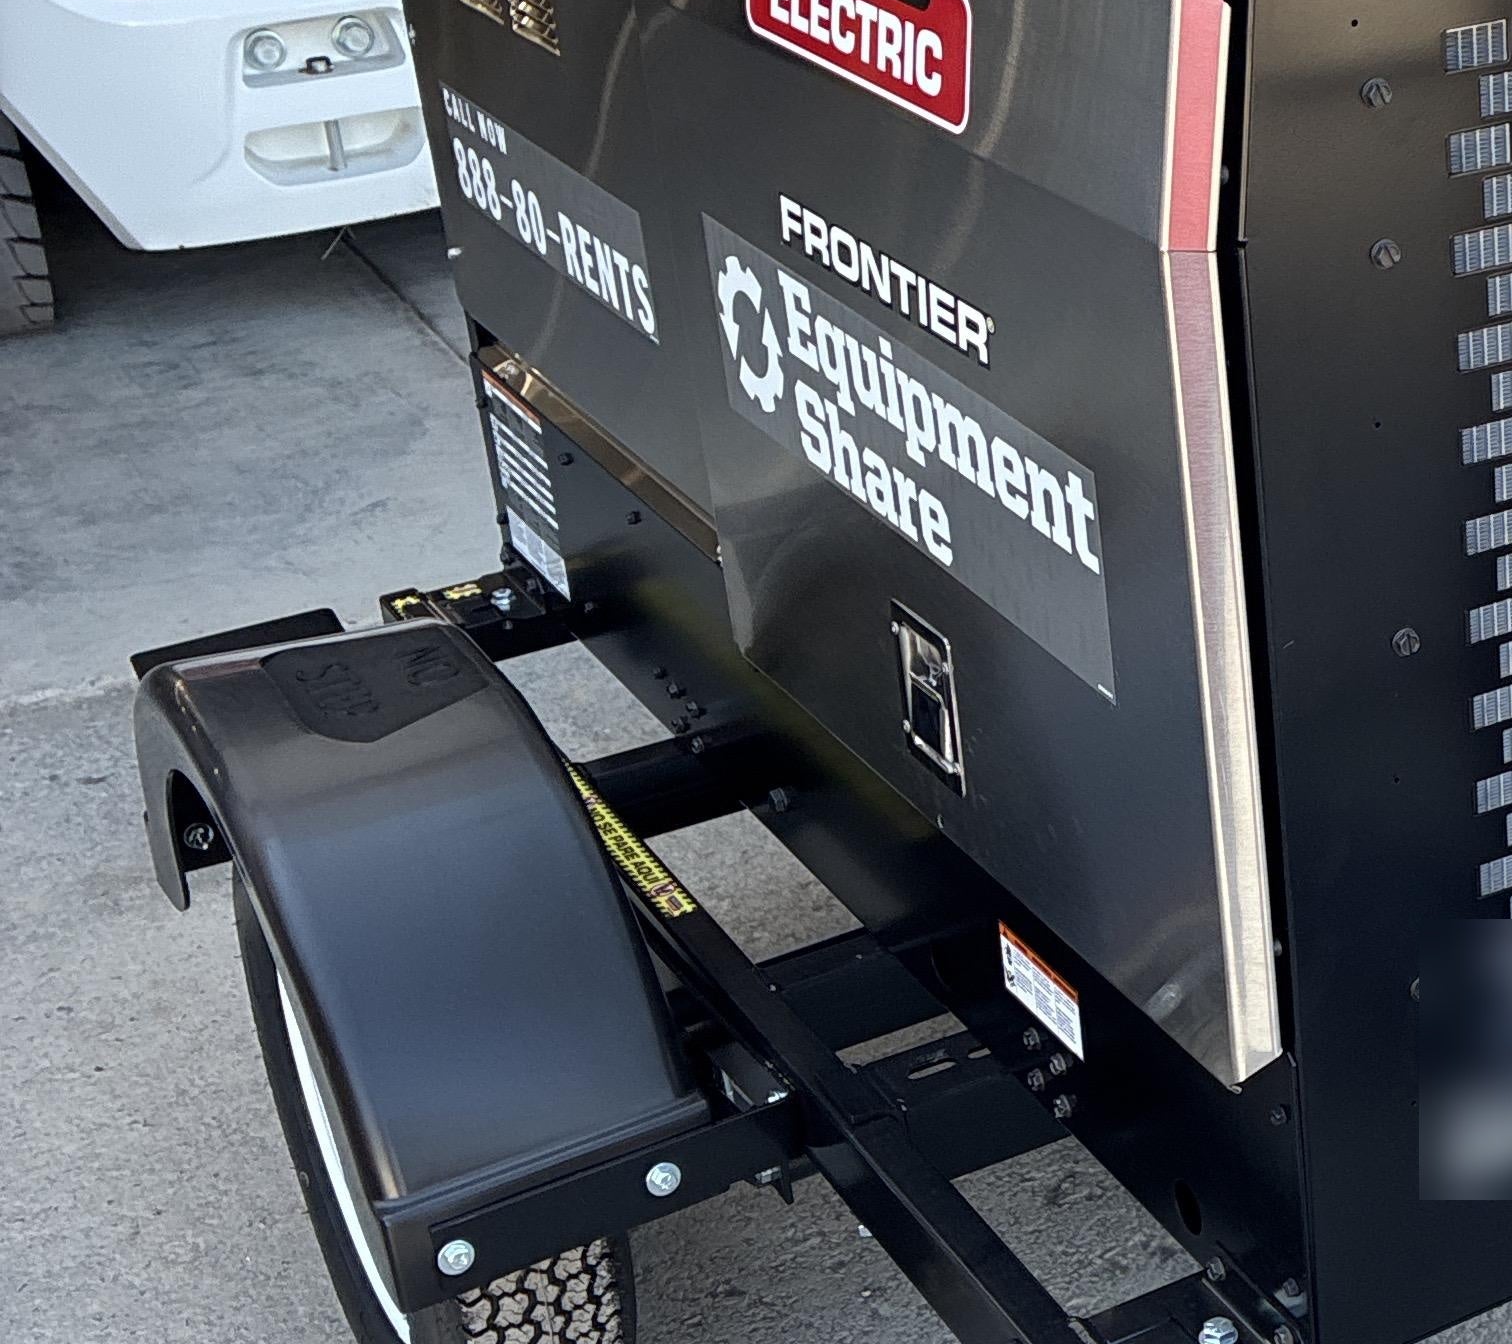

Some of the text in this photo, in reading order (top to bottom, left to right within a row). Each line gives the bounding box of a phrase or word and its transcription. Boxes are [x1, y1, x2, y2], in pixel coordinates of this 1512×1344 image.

[442, 87, 508, 155] CALL NOW
[453, 136, 655, 335] 888-80-RENTS
[779, 194, 990, 365] FRONTIER
[777, 268, 1101, 575] Equipment
[794, 378, 954, 568] Share
